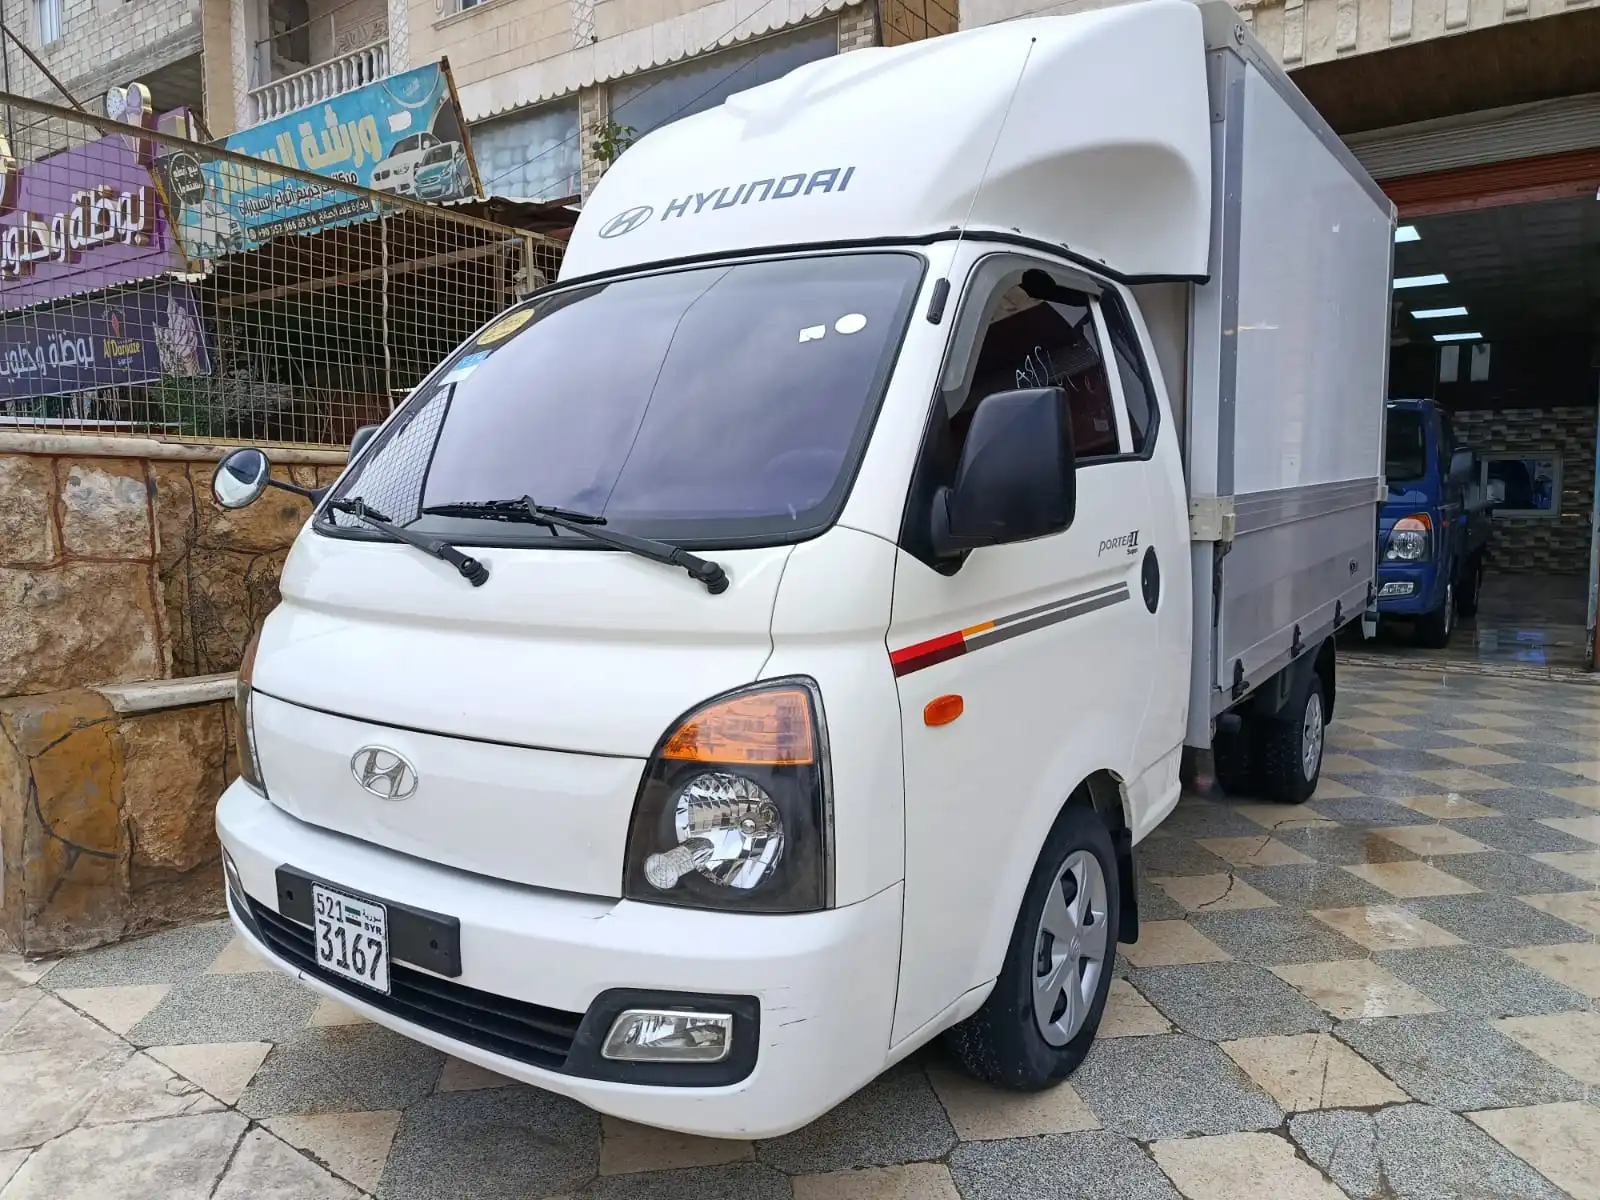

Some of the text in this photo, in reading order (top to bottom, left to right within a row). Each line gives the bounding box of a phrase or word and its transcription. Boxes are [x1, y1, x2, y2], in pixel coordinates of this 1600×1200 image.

[299, 104, 382, 169] ورشة
[70, 184, 145, 248] بوظة
[661, 167, 856, 221] HYUNDAI
[48, 329, 94, 369] بوظة
[316, 892, 344, 923] 521
[364, 922, 382, 936] SYR
[318, 919, 383, 982] 3167
